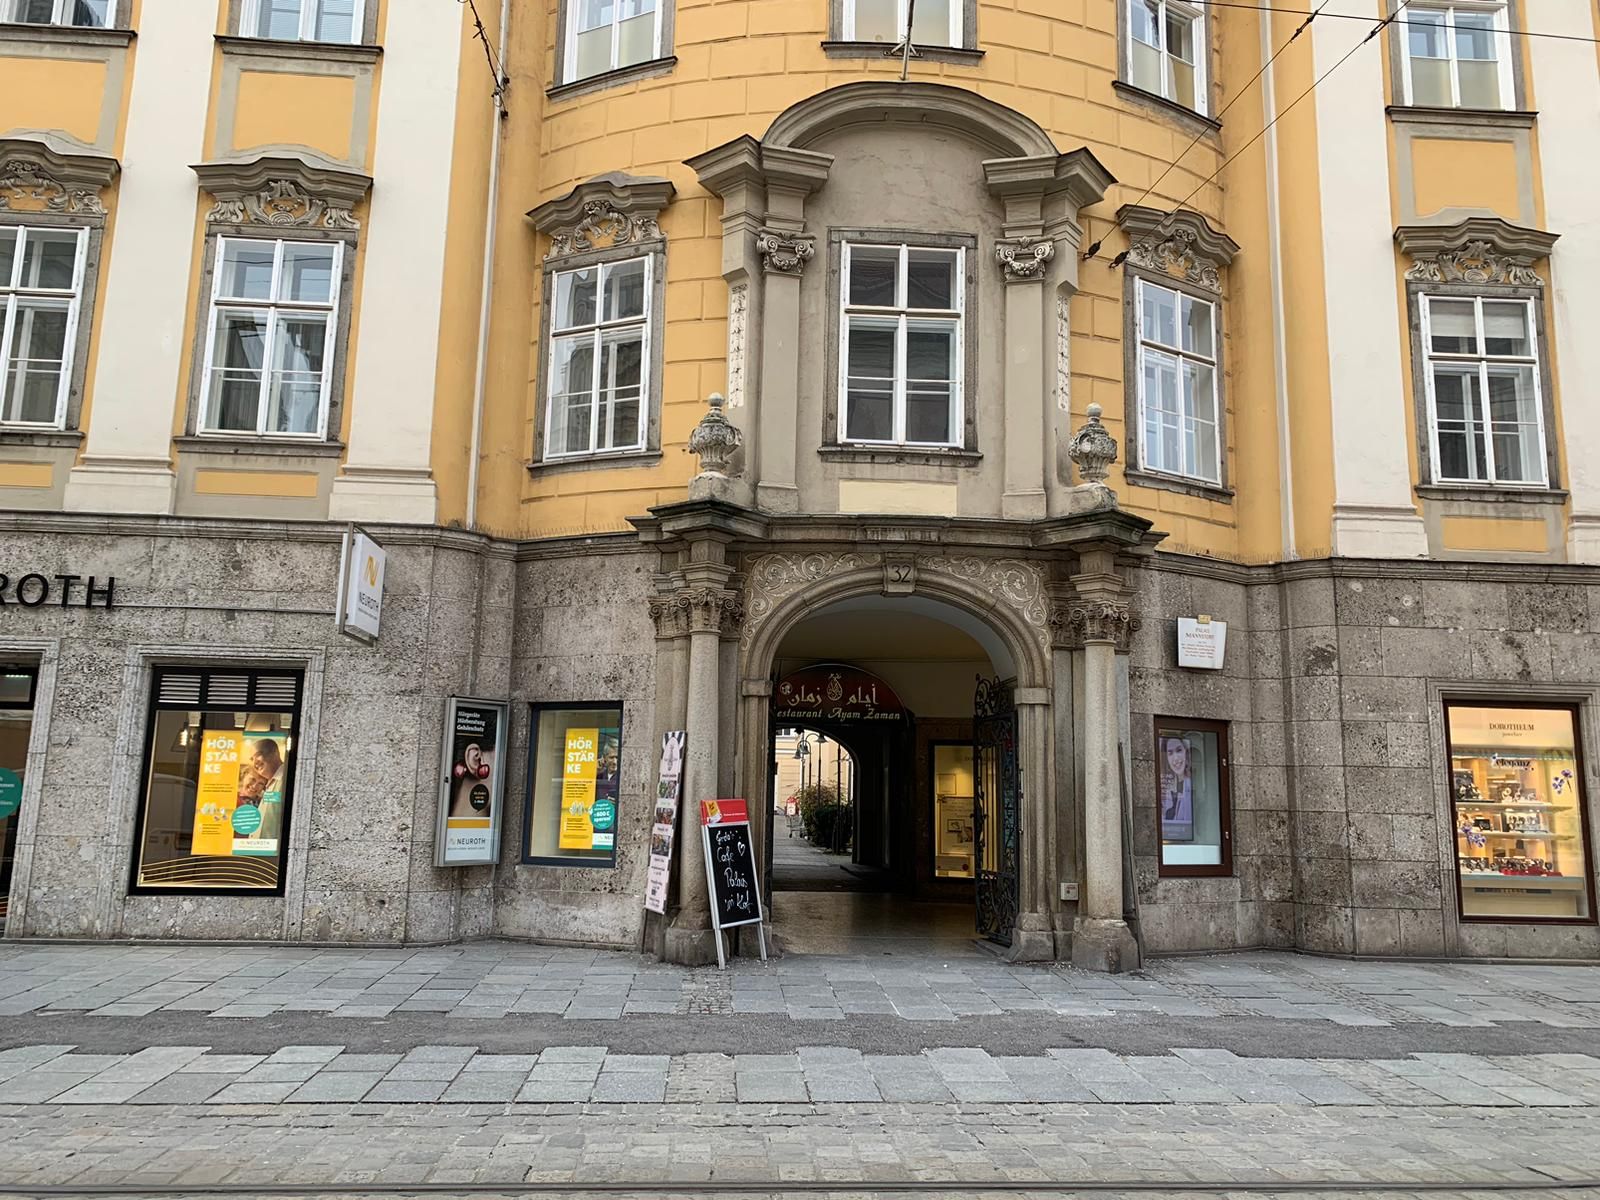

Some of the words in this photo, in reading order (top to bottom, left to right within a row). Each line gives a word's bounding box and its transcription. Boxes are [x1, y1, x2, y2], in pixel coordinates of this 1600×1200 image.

[890, 564, 911, 582] 32
[359, 592, 379, 611] NEUROTH
[777, 708, 822, 718] estaurant
[828, 707, 860, 721] Ayam
[864, 707, 900, 720] Zaman
[1489, 723, 1534, 731] DOROTHEUM
[206, 736, 235, 749] HÖR
[568, 736, 593, 750] HÖR
[205, 750, 237, 762] STÄR
[567, 750, 595, 762] STÄR
[204, 763, 221, 773] KE
[567, 763, 581, 774] KE
